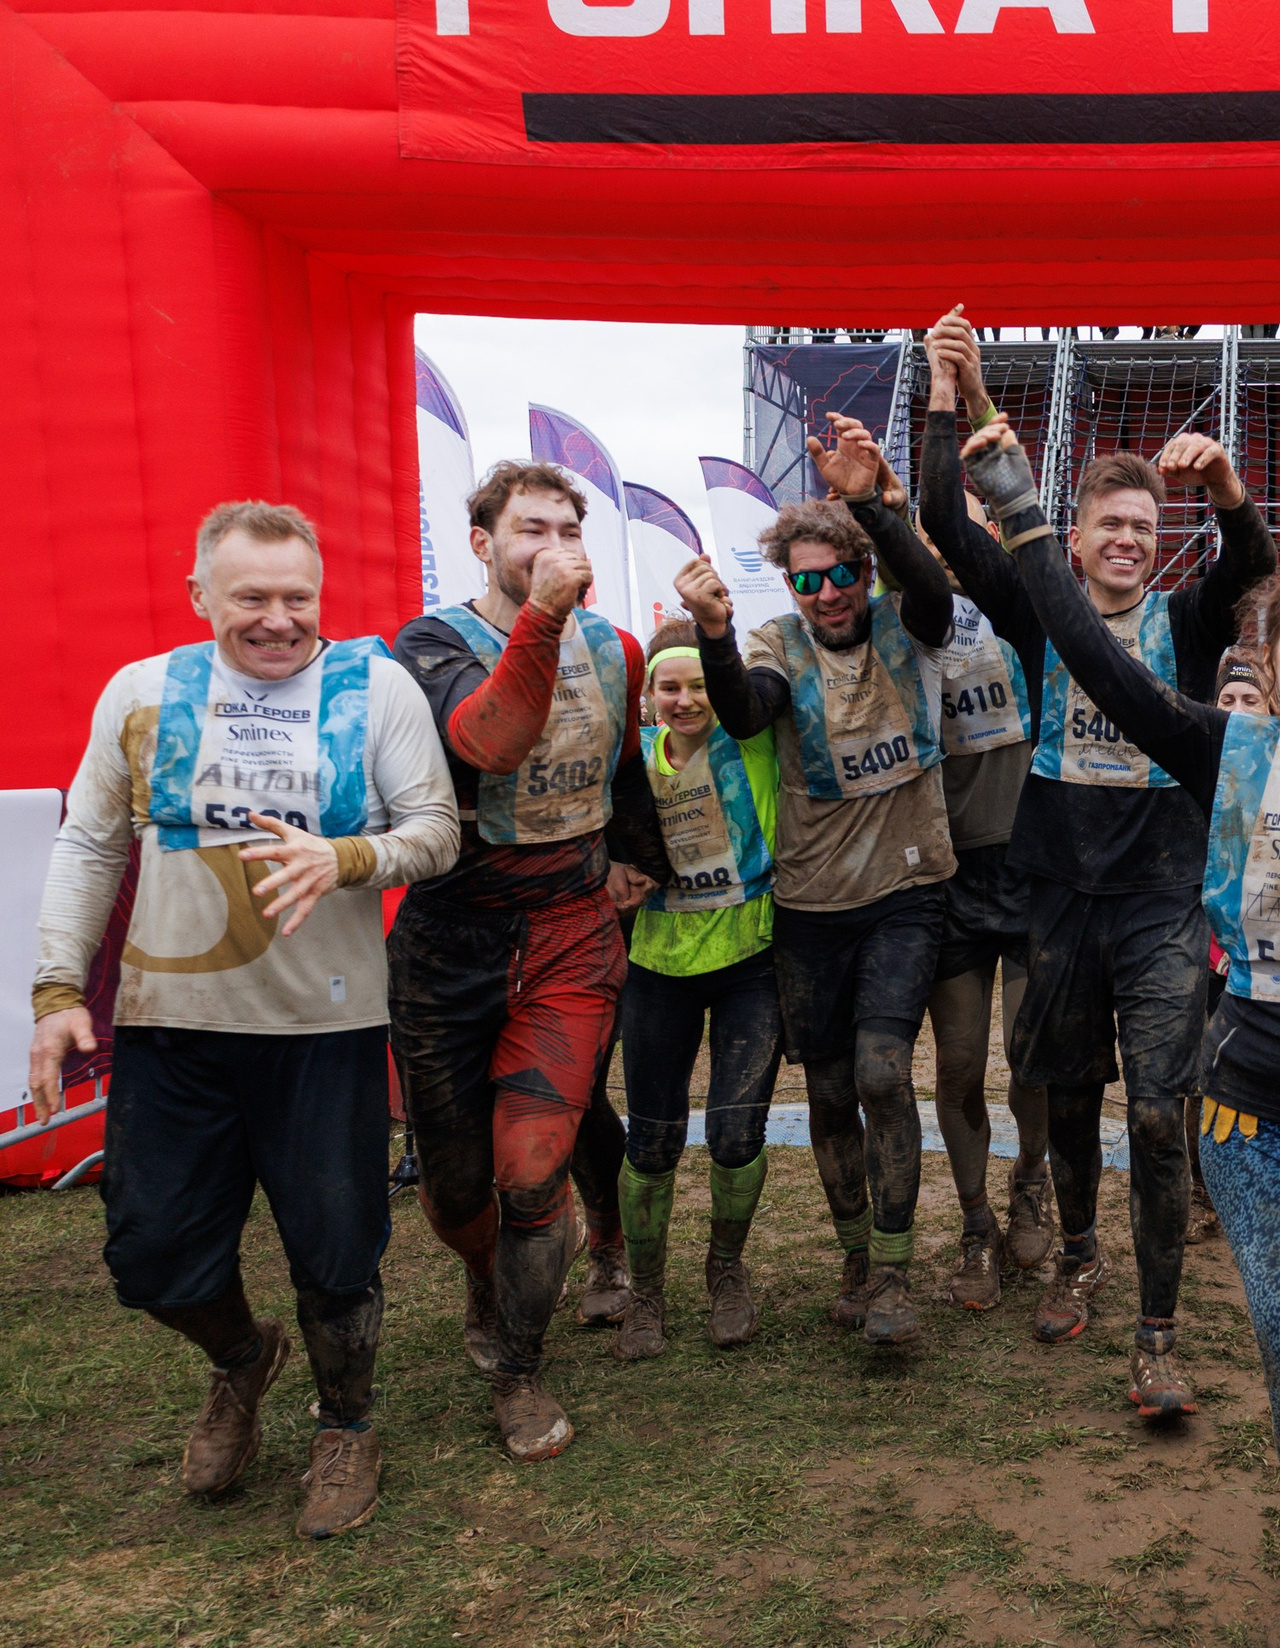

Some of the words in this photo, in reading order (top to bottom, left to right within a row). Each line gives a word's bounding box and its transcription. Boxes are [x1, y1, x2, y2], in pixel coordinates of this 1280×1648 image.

[942, 681, 1008, 719] 5410
[253, 704, 311, 719] ГЕРОЕВ
[226, 723, 293, 742] Sminex
[1072, 707, 1133, 745] 540
[842, 735, 911, 781] 5400
[1088, 761, 1132, 772] ГАЗПРОМБАНК
[528, 756, 603, 797] 5402
[674, 784, 711, 802] ГЕРОЕВ
[1263, 883, 1279, 891] FINE
